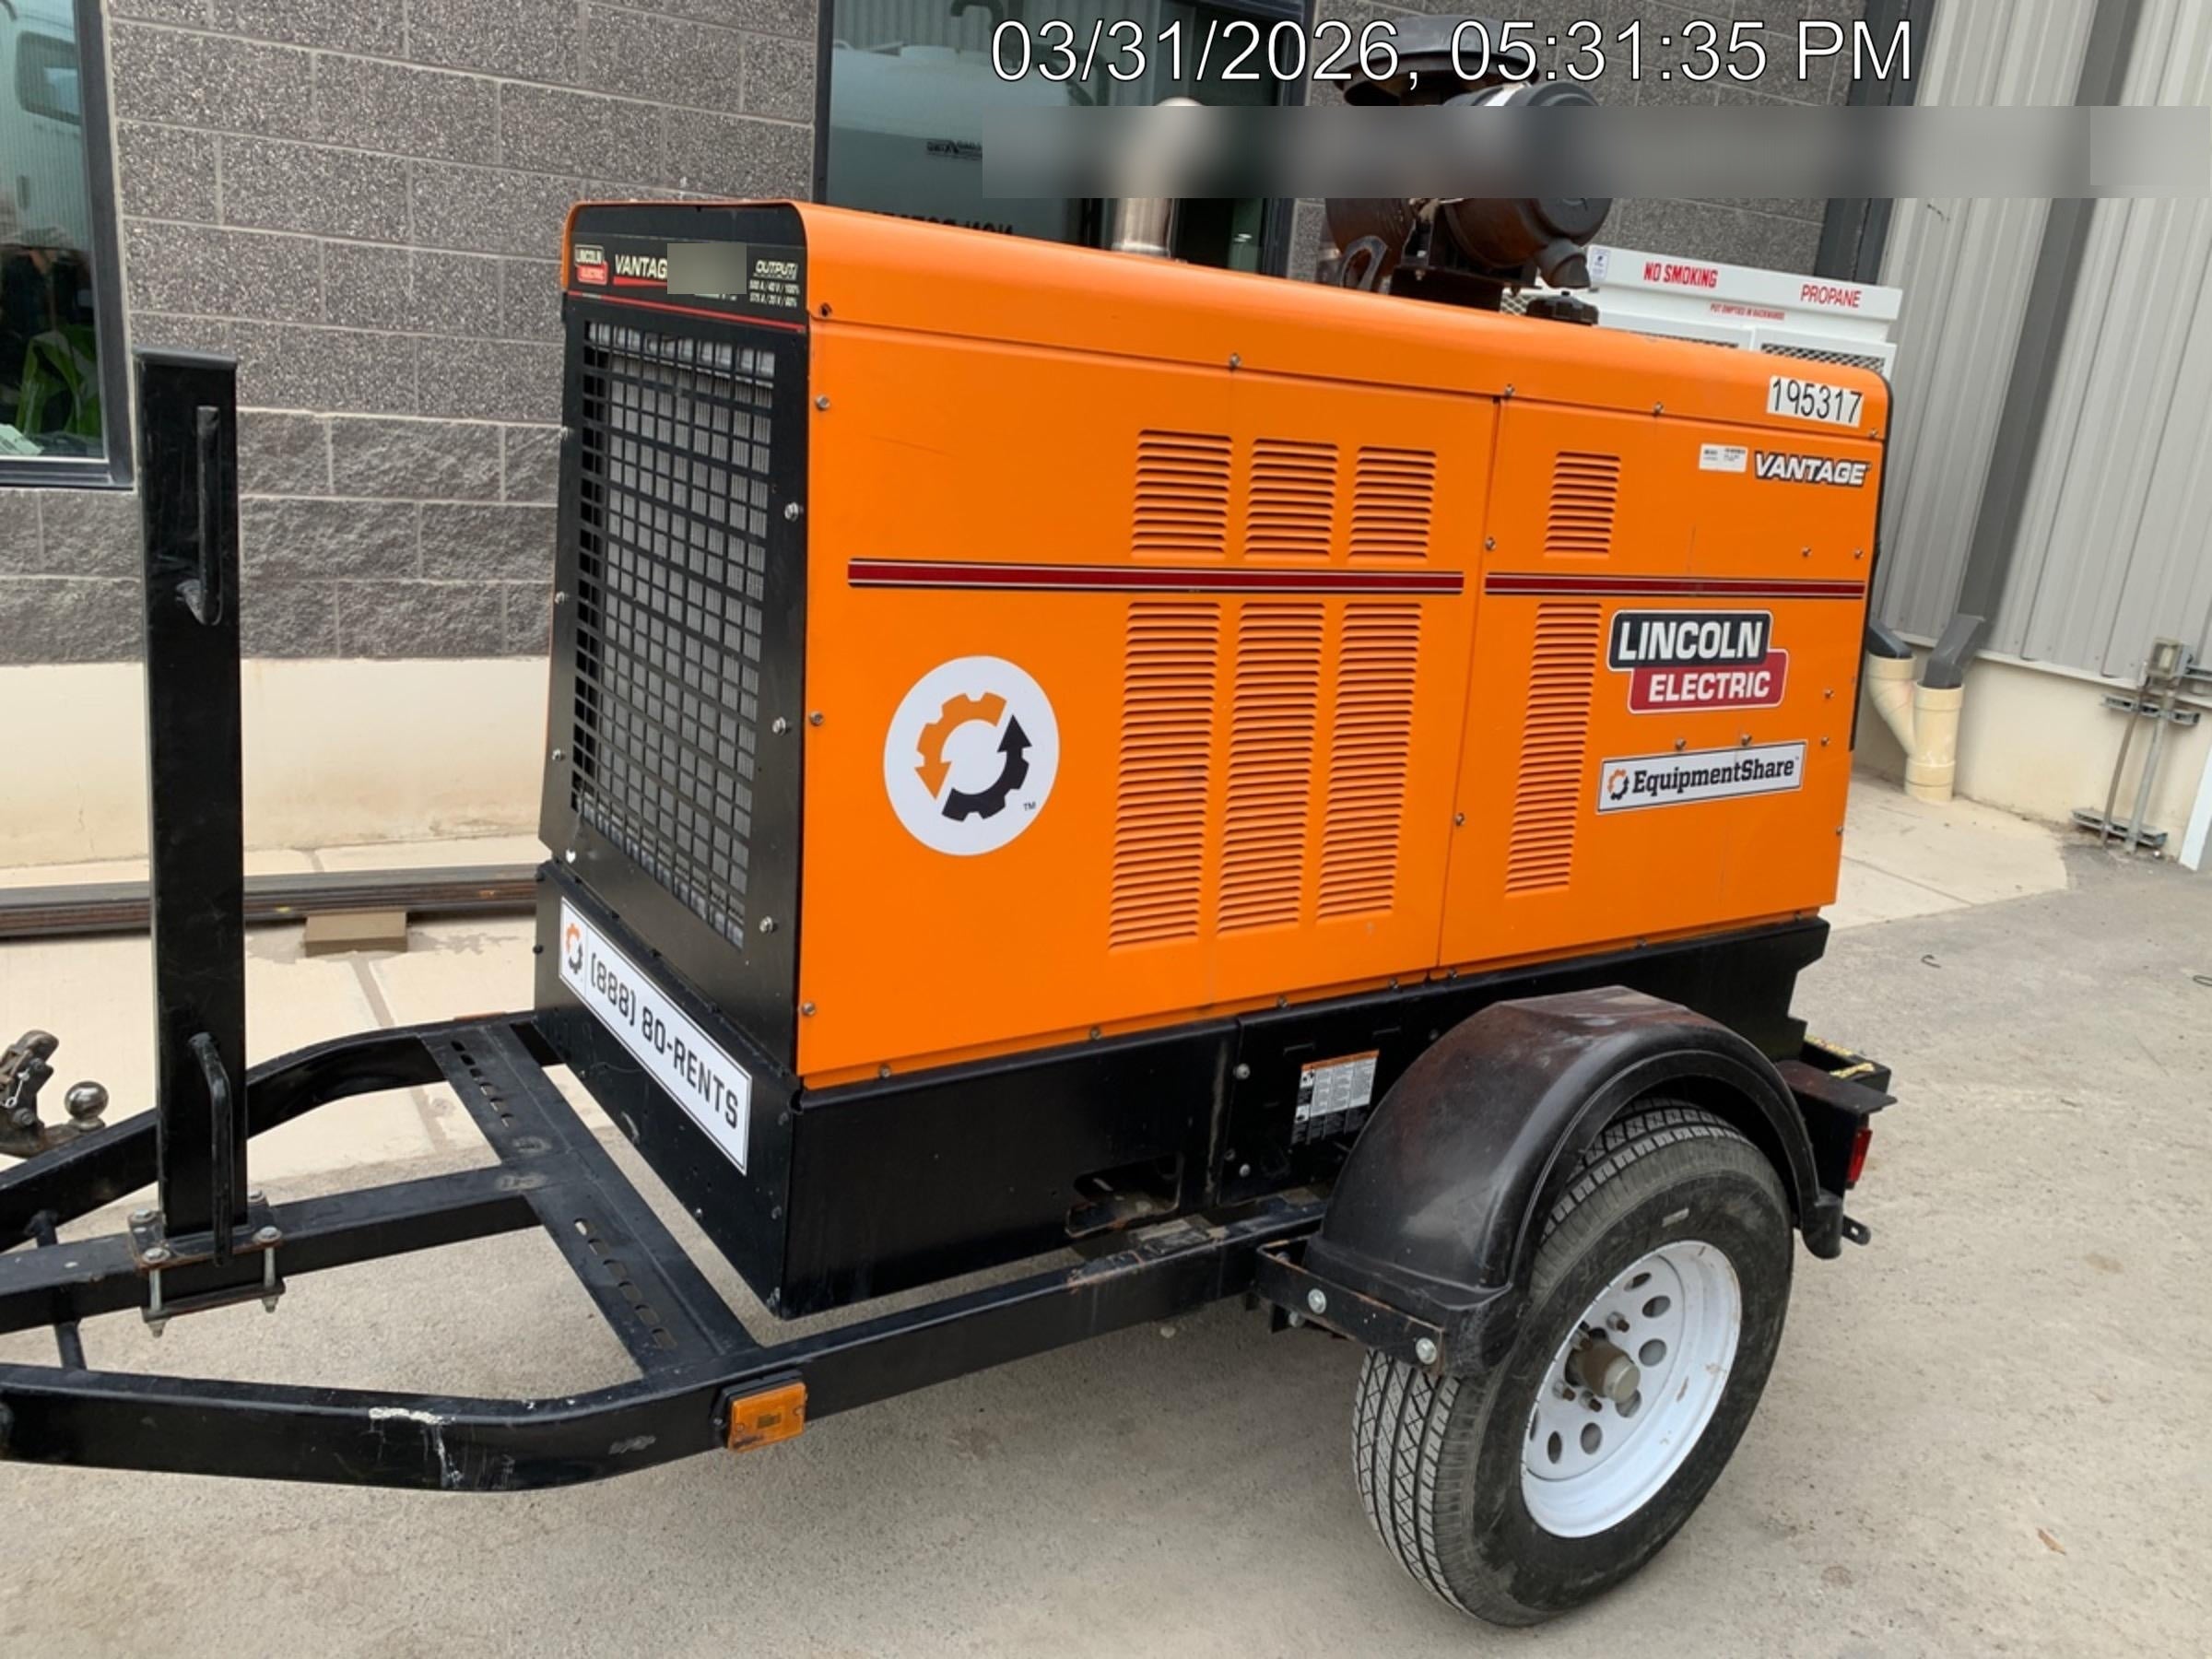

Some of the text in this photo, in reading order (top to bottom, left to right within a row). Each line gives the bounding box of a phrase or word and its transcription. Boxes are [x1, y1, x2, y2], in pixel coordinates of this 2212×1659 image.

[615, 253, 667, 279] VANTAG
[1643, 262, 1719, 288] NO SMOKING
[1800, 284, 1862, 308] PROPANE
[1772, 378, 1863, 423] 195317
[1755, 452, 1867, 487] VANTAGE
[1618, 621, 1763, 661] LINCOLN
[1648, 671, 1771, 702] ELECTRIC
[1632, 759, 1794, 796] EquipmentShare
[591, 952, 738, 1129] (888) 80-RENTS
